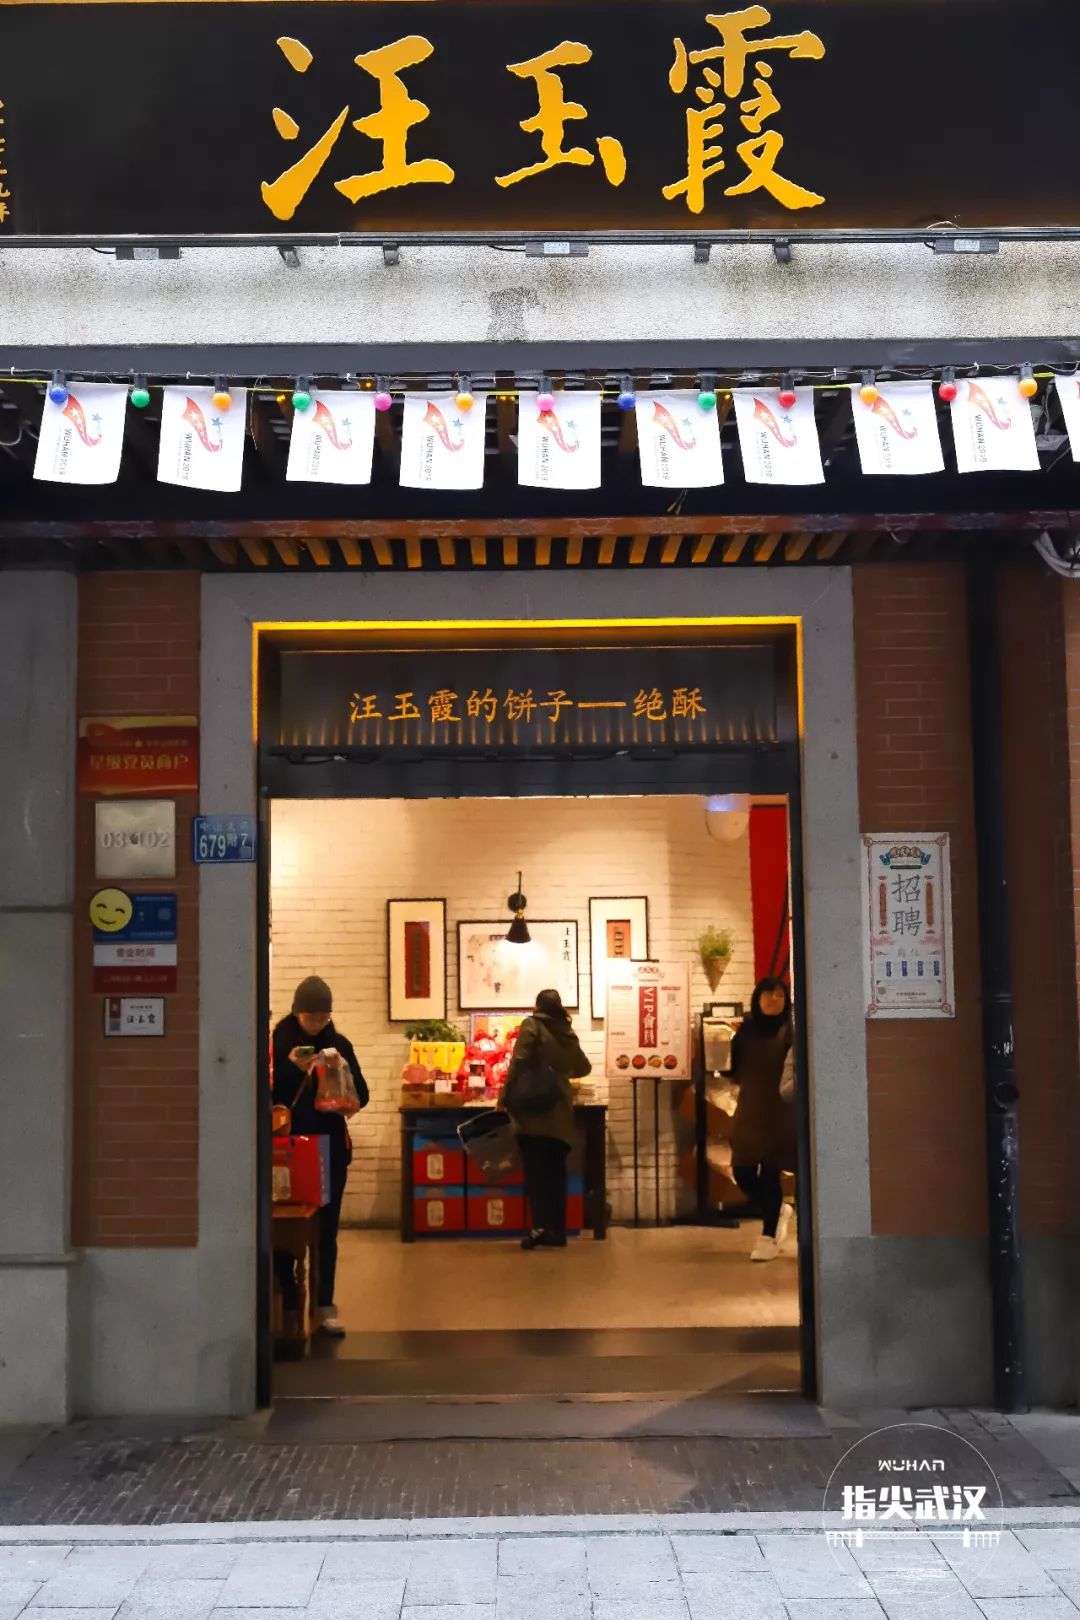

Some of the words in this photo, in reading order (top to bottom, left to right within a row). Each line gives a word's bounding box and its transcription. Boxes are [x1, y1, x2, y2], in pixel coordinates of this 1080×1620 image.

[260, 6, 826, 221] 汪玉霞
[891, 873, 923, 937] 招聘
